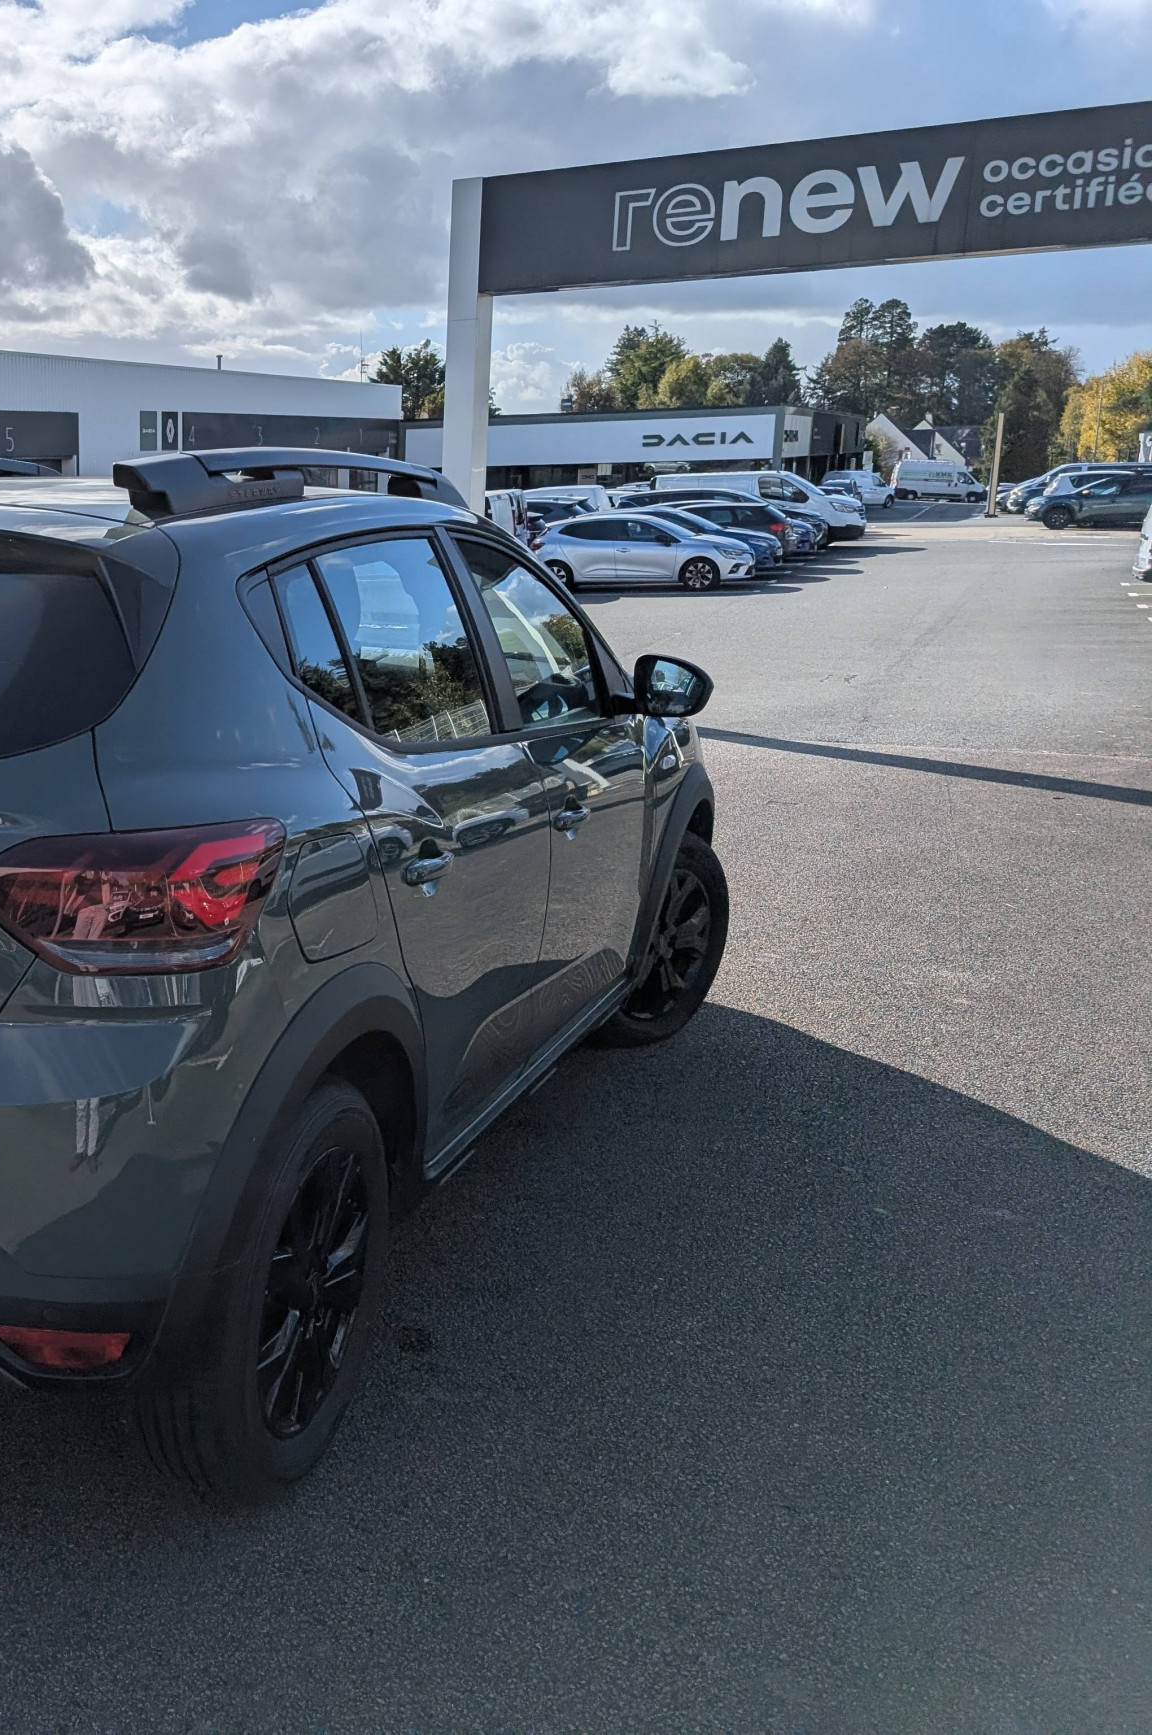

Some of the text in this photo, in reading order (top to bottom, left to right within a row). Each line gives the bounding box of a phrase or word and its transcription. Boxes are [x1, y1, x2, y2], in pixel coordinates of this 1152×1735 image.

[611, 156, 965, 252] renew
[979, 173, 1152, 218] certifié
[5, 427, 15, 452] 5
[188, 426, 196, 446] 4
[257, 427, 263, 446] 3
[314, 427, 320, 445] 2
[642, 431, 754, 447] DACIA
[230, 486, 280, 500] STEPWAY
